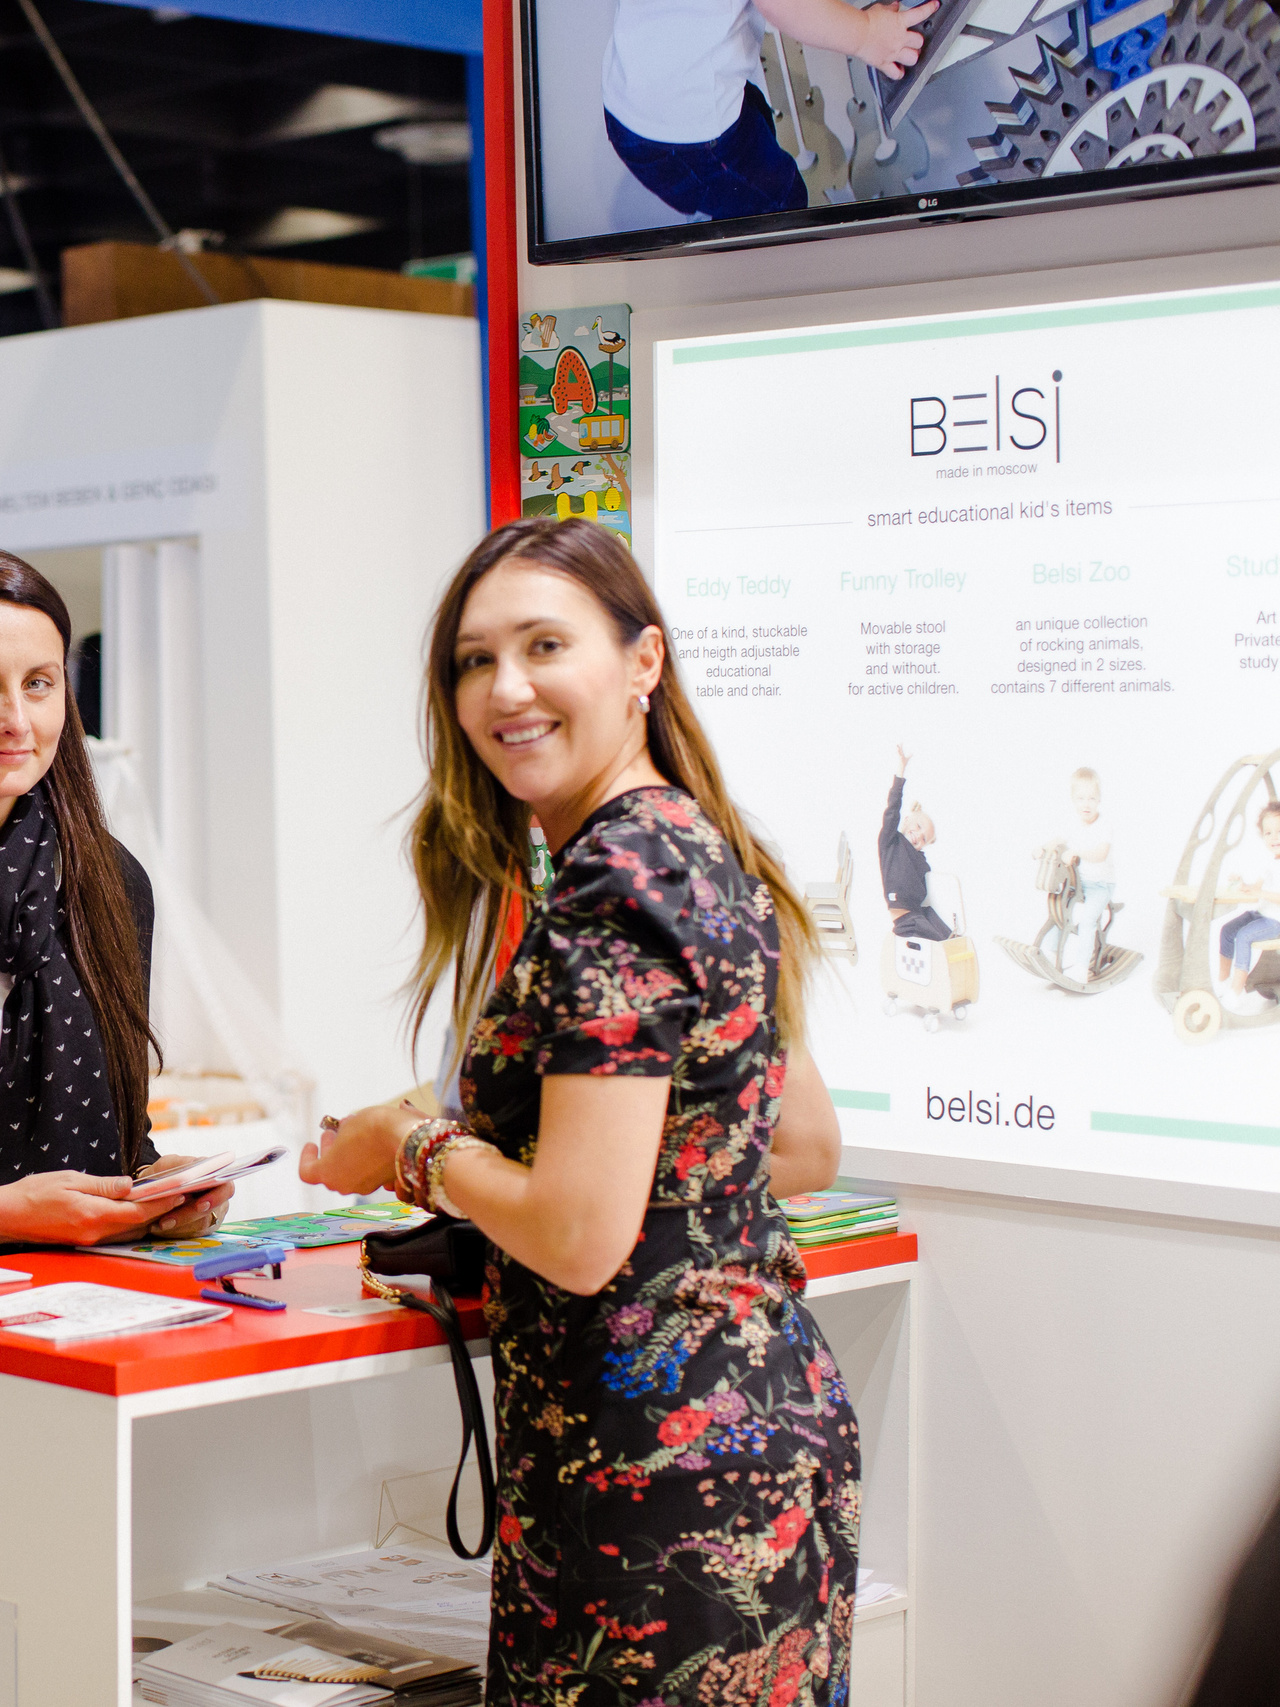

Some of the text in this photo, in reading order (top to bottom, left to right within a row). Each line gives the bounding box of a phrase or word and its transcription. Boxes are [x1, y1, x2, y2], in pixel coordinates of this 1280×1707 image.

[936, 464, 1038, 479] made in moscow
[868, 499, 1112, 527] smart educational kid's items
[1033, 561, 1130, 584] Belsi Zoo
[687, 574, 791, 600] Eddy Teddy
[840, 568, 966, 595] Funny Trolley
[1016, 615, 1147, 632] an unique collection
[1256, 611, 1276, 624] Art
[671, 624, 808, 640] One of a kind, stuckable
[860, 621, 946, 634] Movable stool
[679, 645, 800, 661] and heigth adjustable
[866, 642, 940, 657] with storage
[1020, 636, 1143, 654] of rocking animals,
[706, 664, 771, 677] educational
[866, 662, 940, 675] and without.
[1018, 658, 1146, 675] designed in 2 sizes.
[696, 684, 782, 696] table and chair.
[848, 682, 959, 695] for active children.
[991, 679, 1174, 693] contains 7 different animals.
[926, 1087, 1056, 1131] belsi.de
